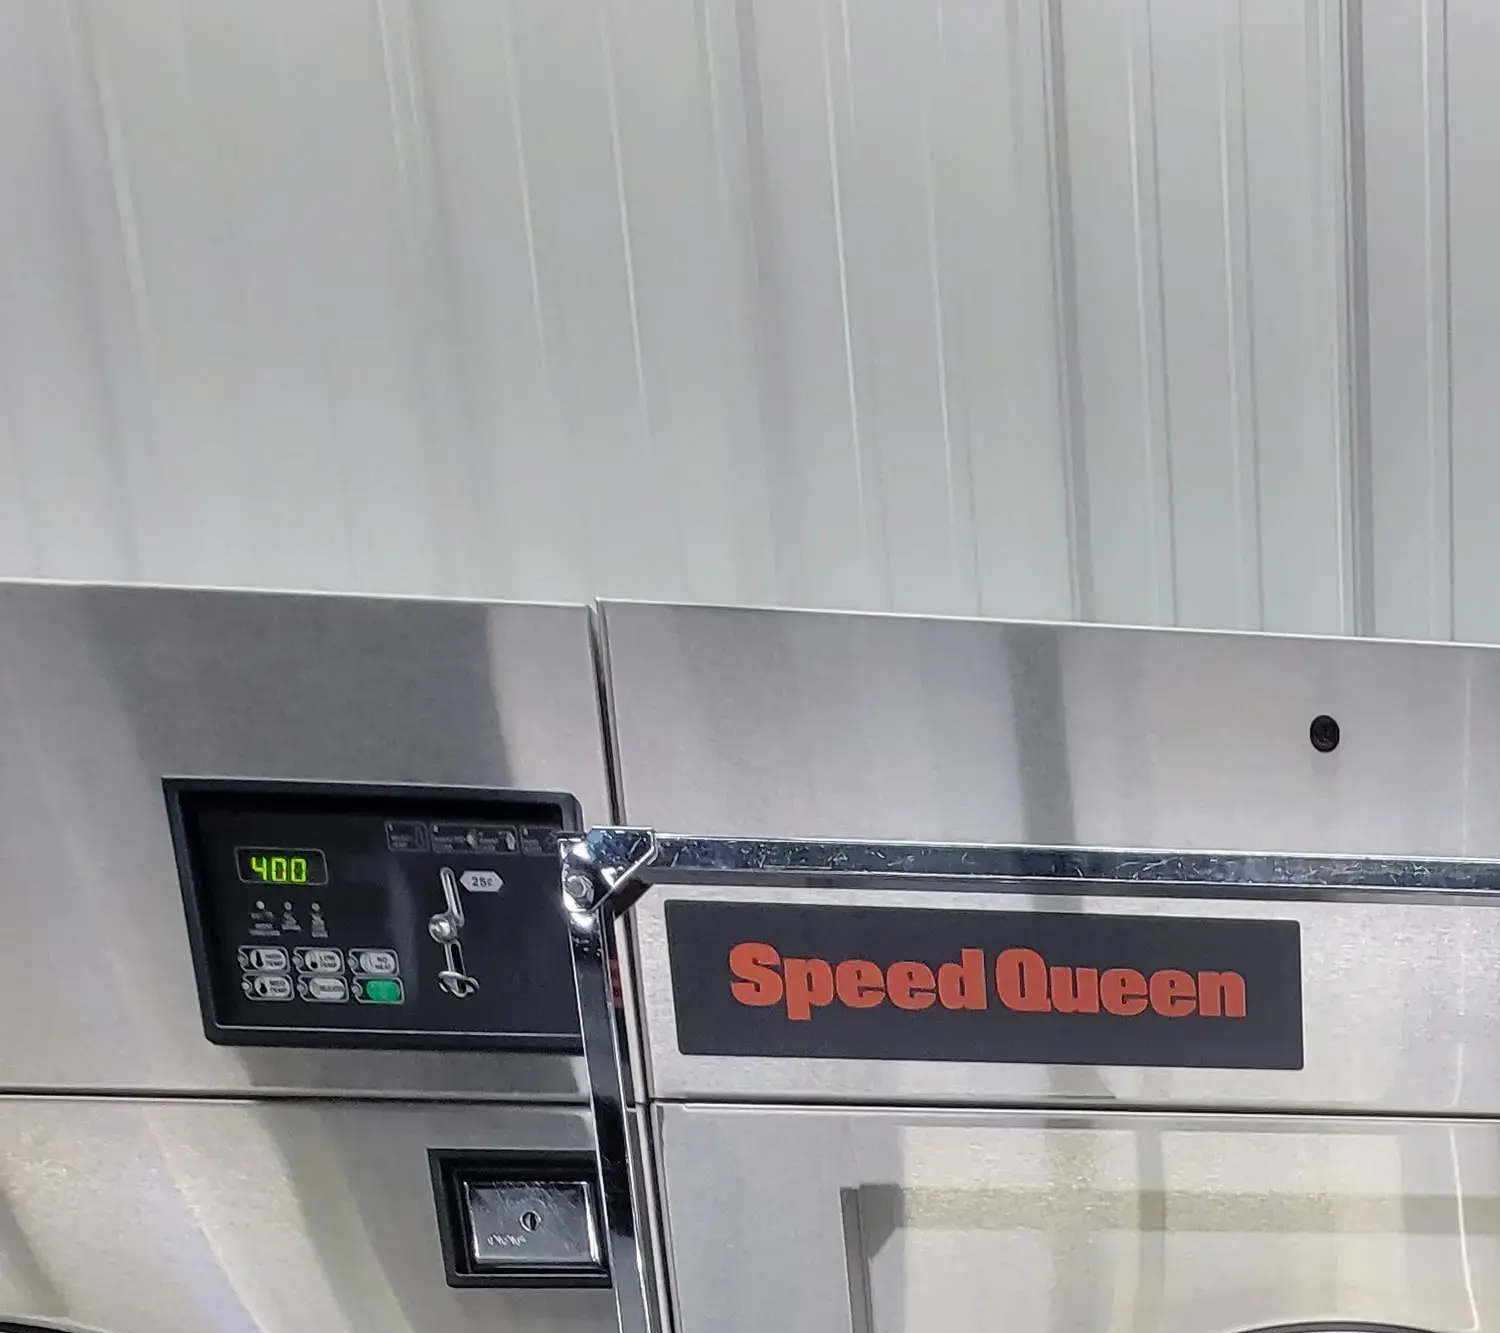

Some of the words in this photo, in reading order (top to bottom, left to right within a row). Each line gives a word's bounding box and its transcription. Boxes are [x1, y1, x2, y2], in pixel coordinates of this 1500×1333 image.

[251, 856, 307, 883] 400
[471, 876, 493, 887] 25¢
[731, 943, 986, 1019] Speed
[995, 949, 1245, 1017] Queen
